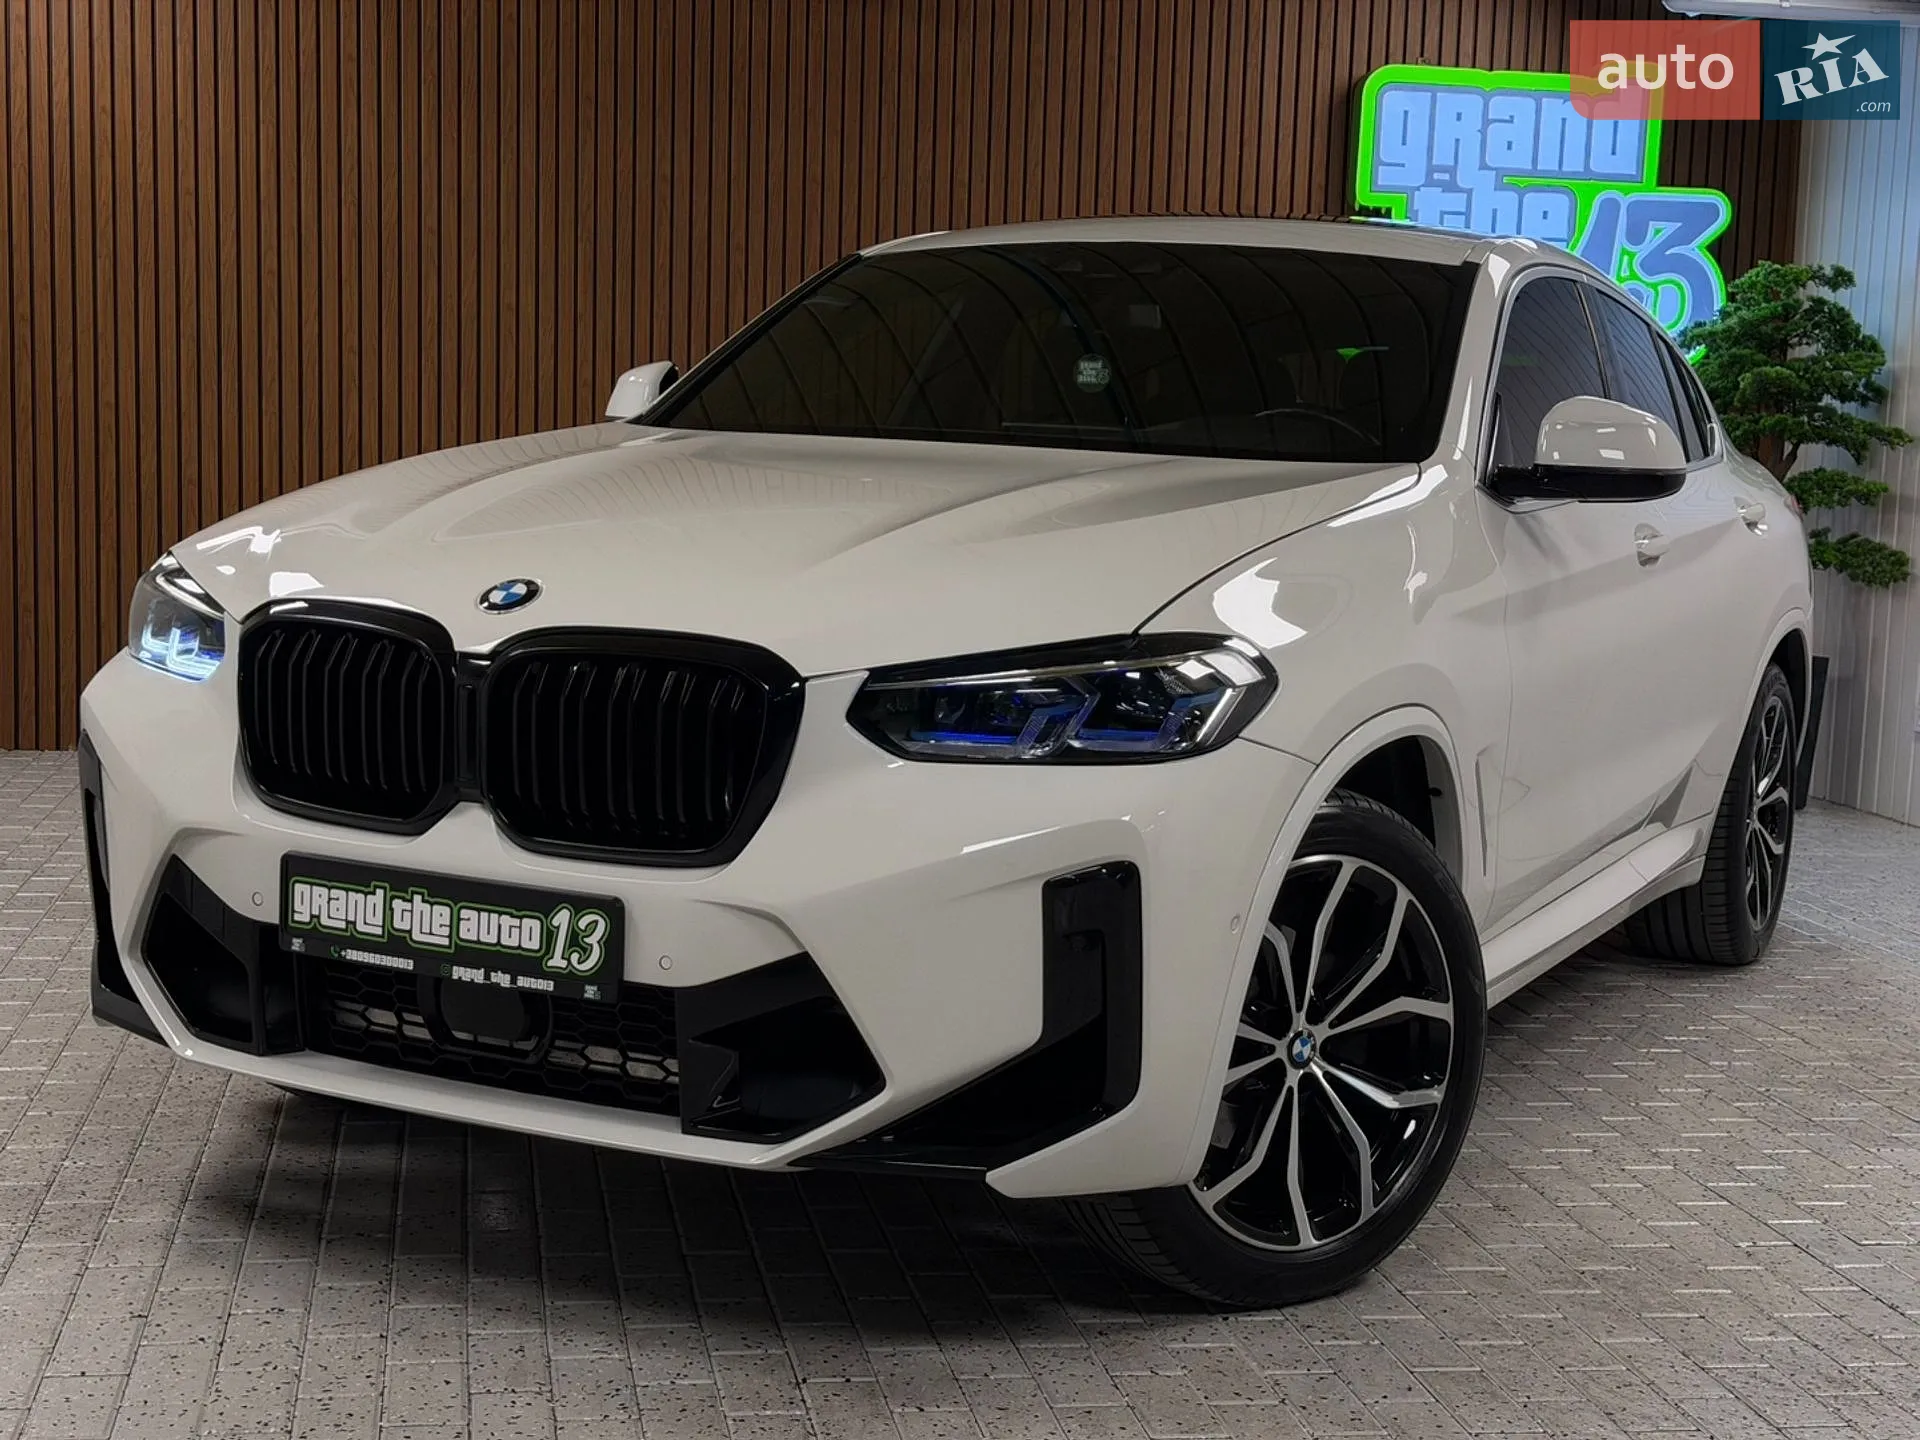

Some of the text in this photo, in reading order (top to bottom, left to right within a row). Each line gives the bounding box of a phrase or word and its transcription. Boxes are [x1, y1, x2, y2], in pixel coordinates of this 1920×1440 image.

[392, 894, 450, 946] the
[459, 908, 540, 950] auto
[547, 907, 606, 972] 13
